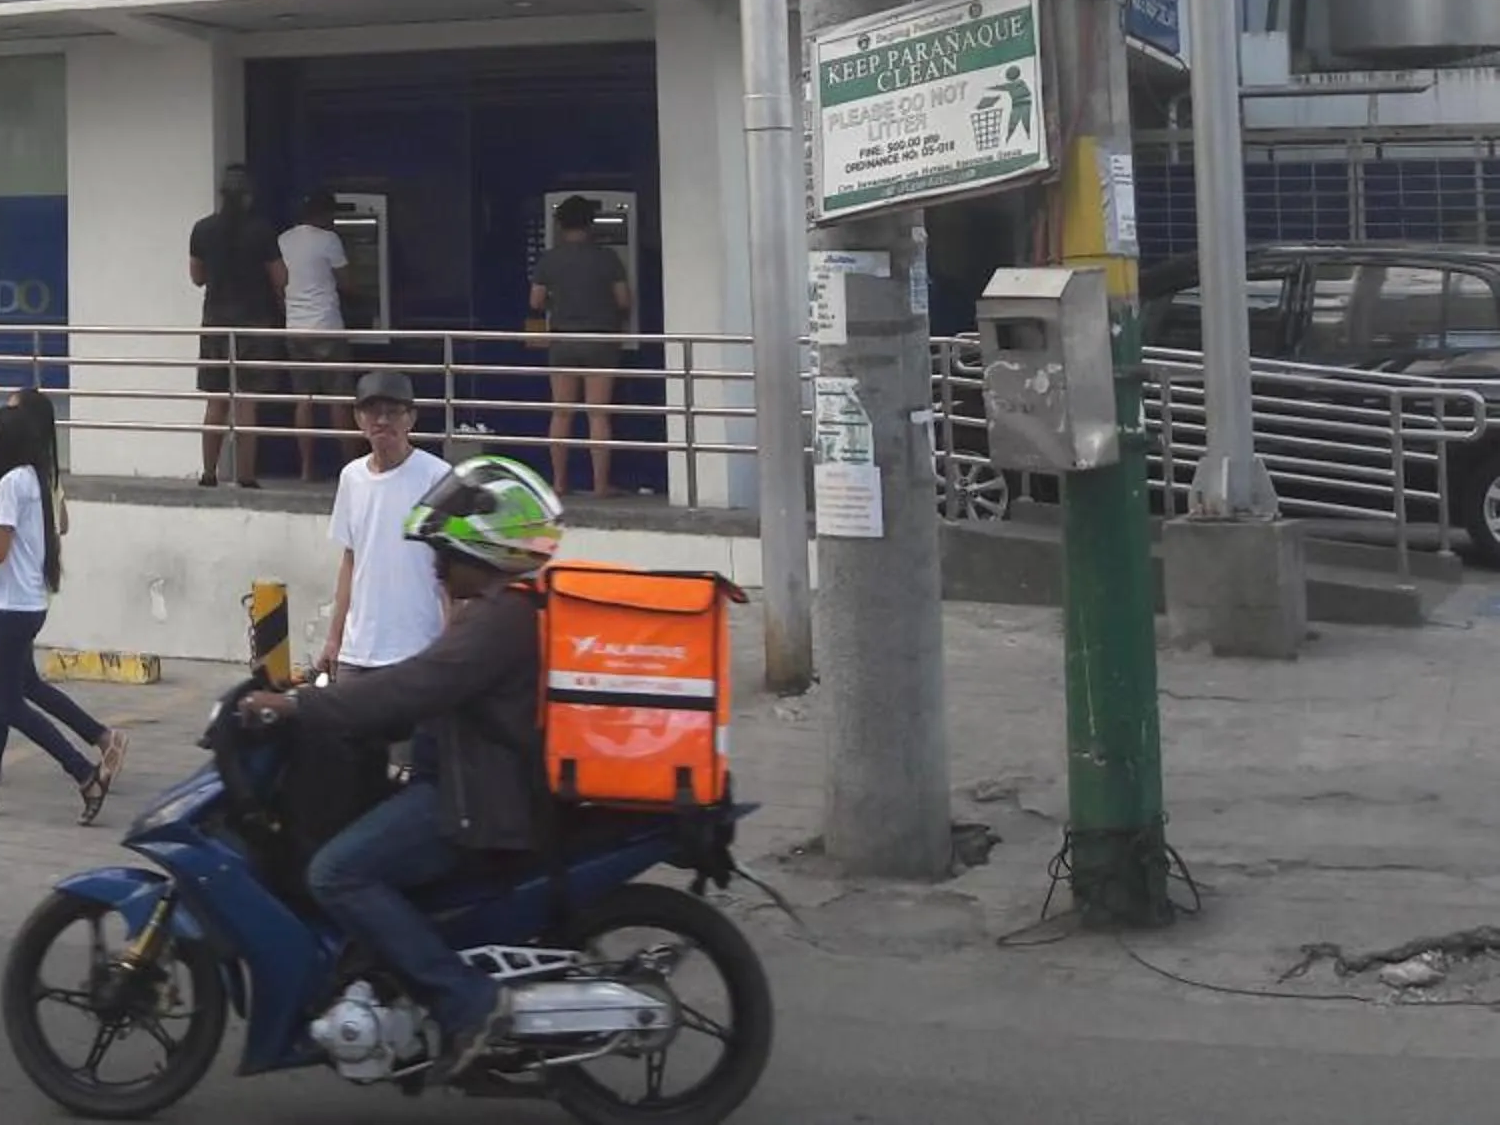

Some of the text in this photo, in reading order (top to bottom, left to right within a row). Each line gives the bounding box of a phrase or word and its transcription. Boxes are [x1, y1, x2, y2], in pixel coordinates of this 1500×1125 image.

[828, 55, 880, 85] KEEP
[888, 14, 1025, 71] PARAÑAQUE
[877, 53, 958, 92] CLEAN
[829, 81, 968, 133] PLEASE DO NOT
[867, 112, 928, 142] LITTER
[844, 153, 900, 174] ORDINANCE
